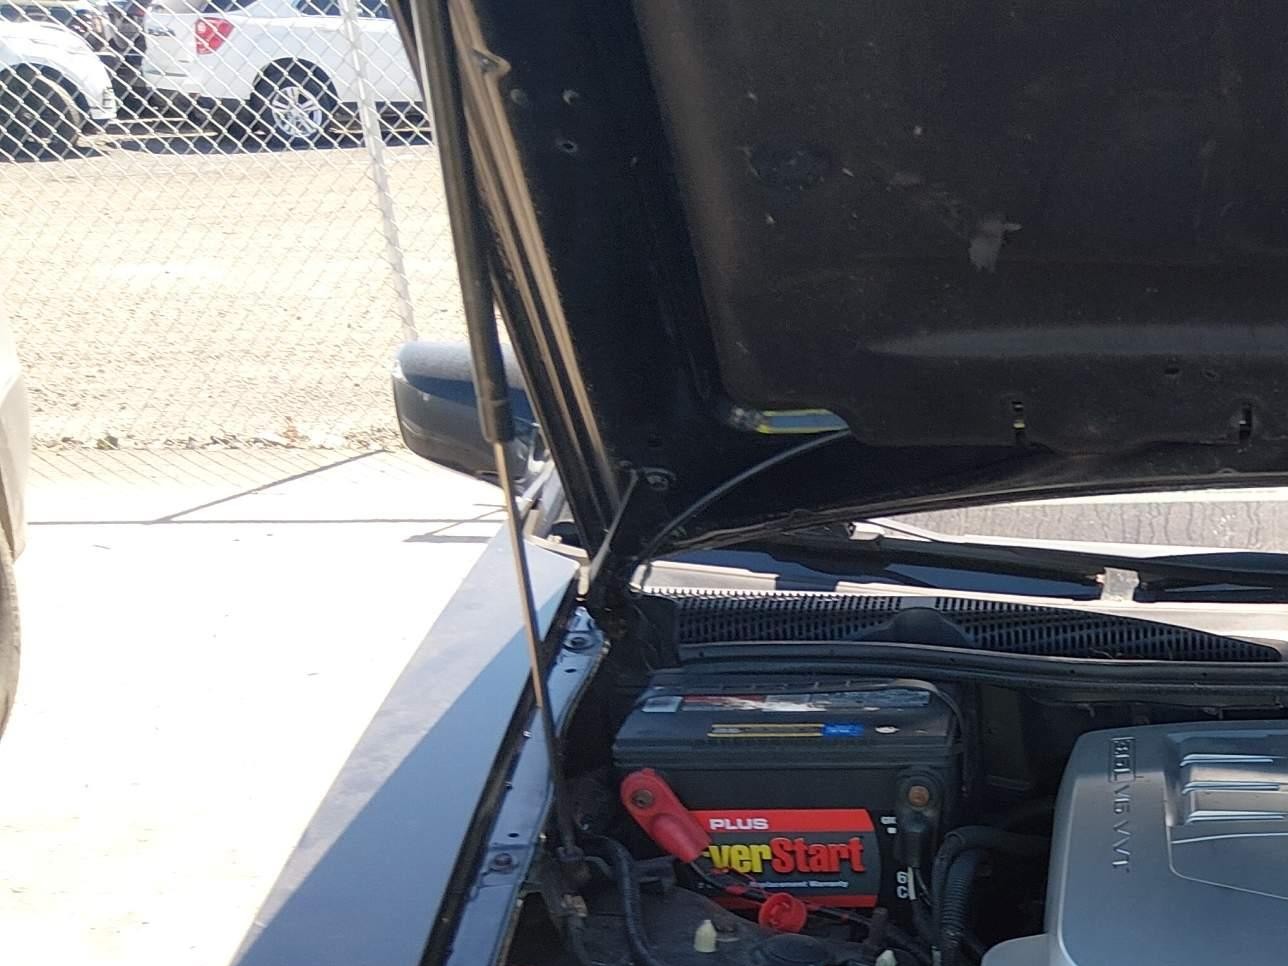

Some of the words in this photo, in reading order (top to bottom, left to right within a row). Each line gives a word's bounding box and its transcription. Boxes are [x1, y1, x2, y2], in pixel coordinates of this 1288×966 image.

[709, 818, 769, 830] PLUS
[706, 837, 864, 873] verStart
[1112, 820, 1131, 872] VVT
